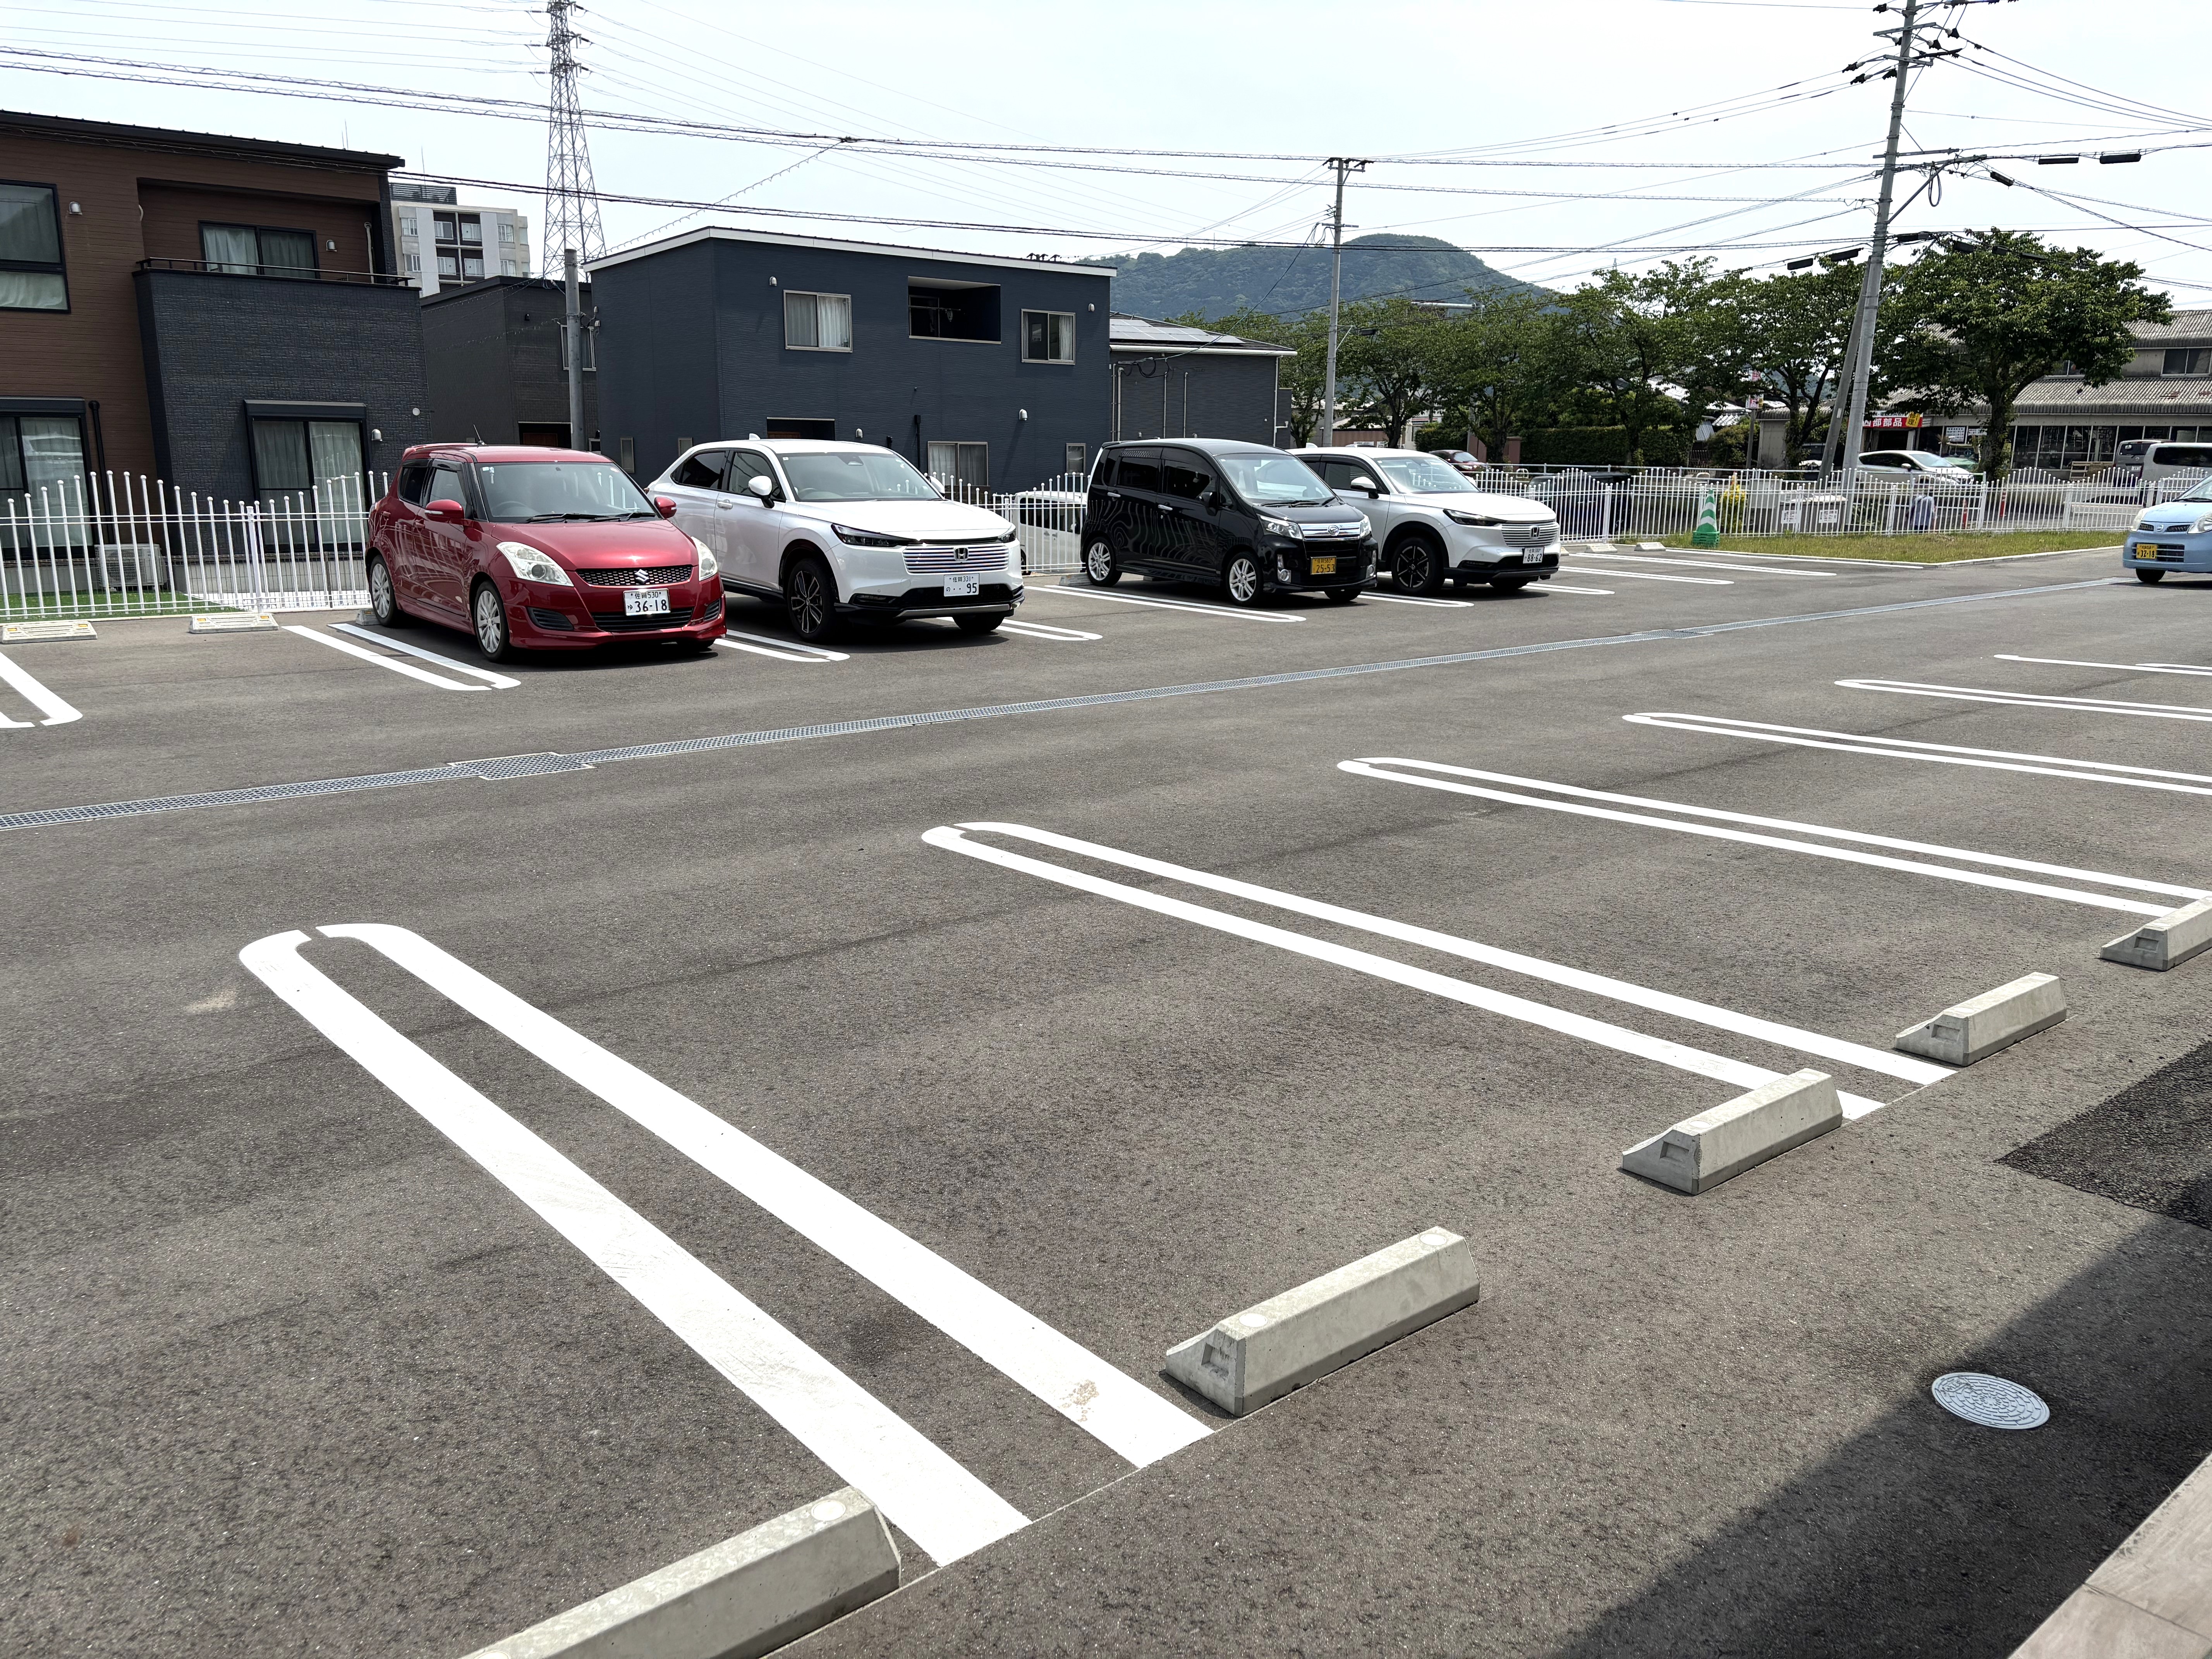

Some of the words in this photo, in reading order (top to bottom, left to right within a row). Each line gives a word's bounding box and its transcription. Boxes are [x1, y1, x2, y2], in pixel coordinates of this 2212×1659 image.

[1527, 553, 1542, 562] 88-62
[1316, 564, 1334, 573] 25-53
[635, 599, 667, 613] 36-18
